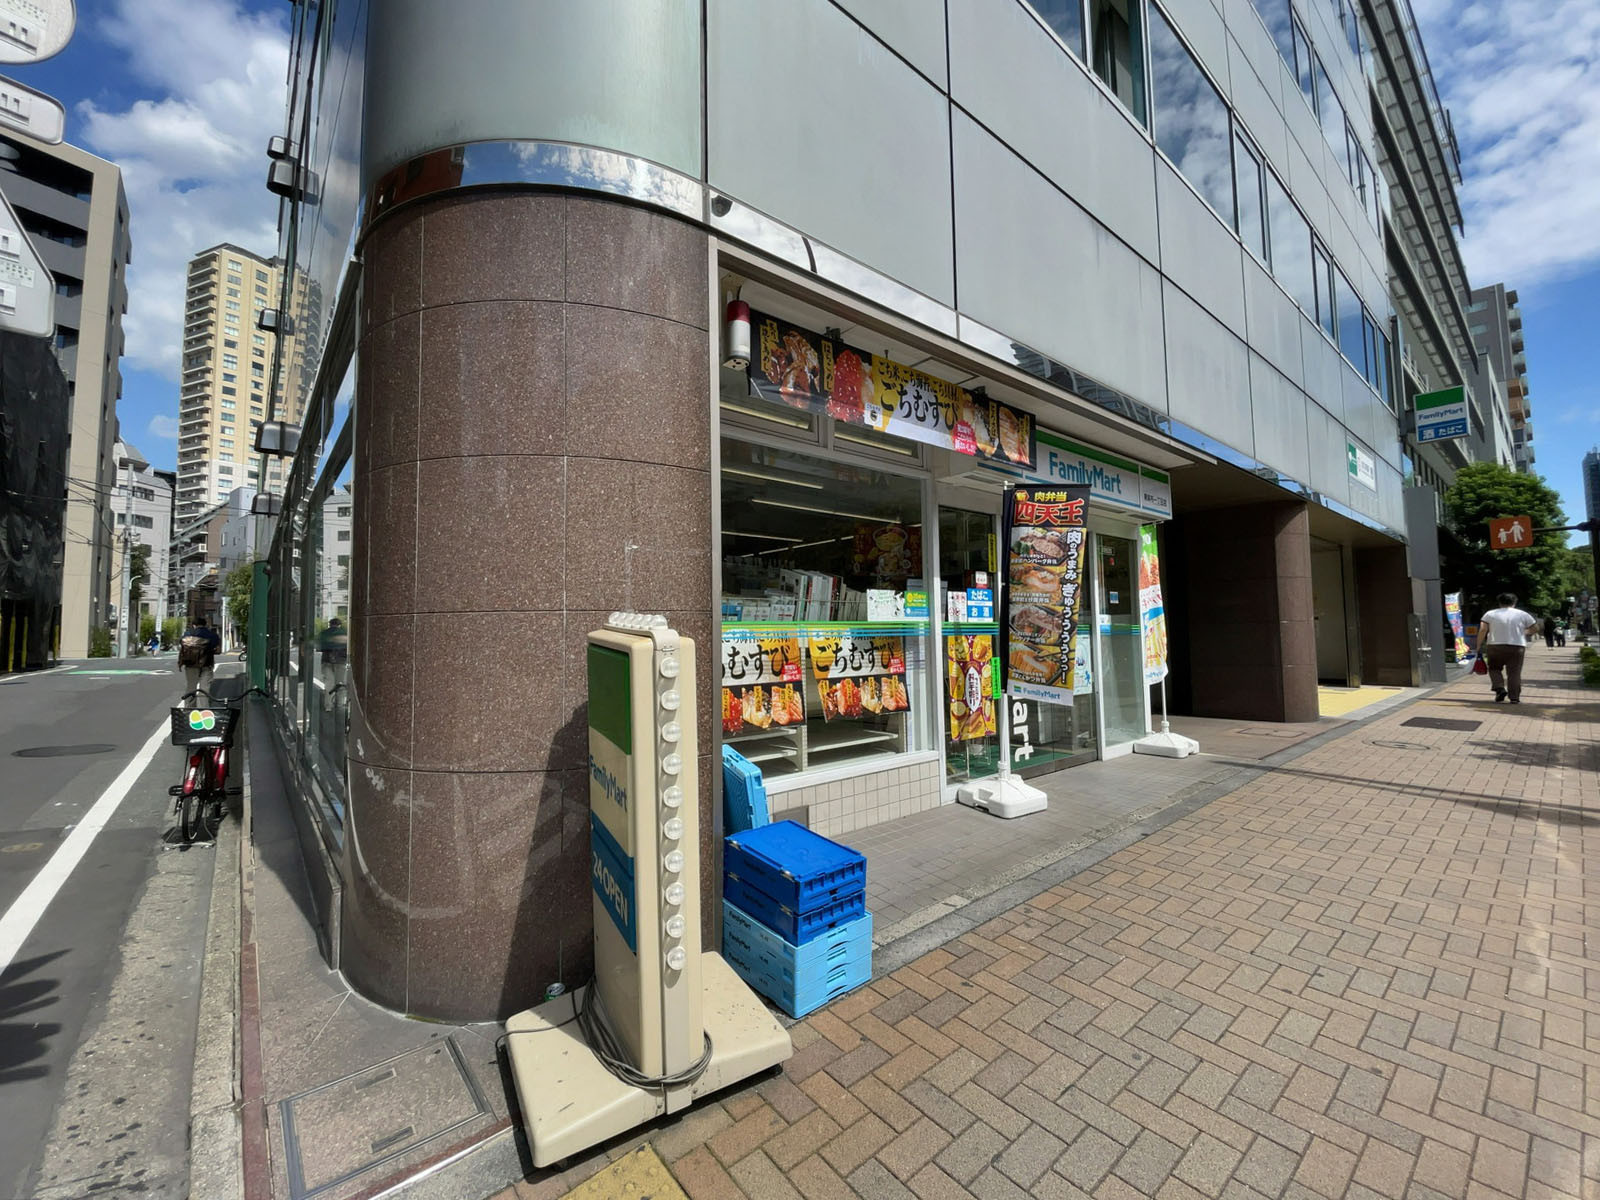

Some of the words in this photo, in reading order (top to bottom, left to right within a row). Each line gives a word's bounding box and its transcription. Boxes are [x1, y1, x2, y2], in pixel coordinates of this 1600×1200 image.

[880, 379, 958, 430] ごちむすび
[1418, 408, 1463, 420] FamilyMart
[1423, 429, 1434, 440] 酒
[1439, 425, 1464, 436] たばこ
[1049, 451, 1122, 494] FamilyMart
[1014, 498, 1084, 525] 四天王
[1034, 491, 1067, 501] 肉弁当
[1065, 530, 1082, 580] 肉のうまみ
[971, 590, 988, 600] たばこ
[722, 645, 790, 680] むすび
[816, 641, 894, 673] ごちむすび
[1023, 687, 1061, 699] FamilyMart
[1012, 700, 1034, 762] art
[590, 753, 627, 812] FamilyMart
